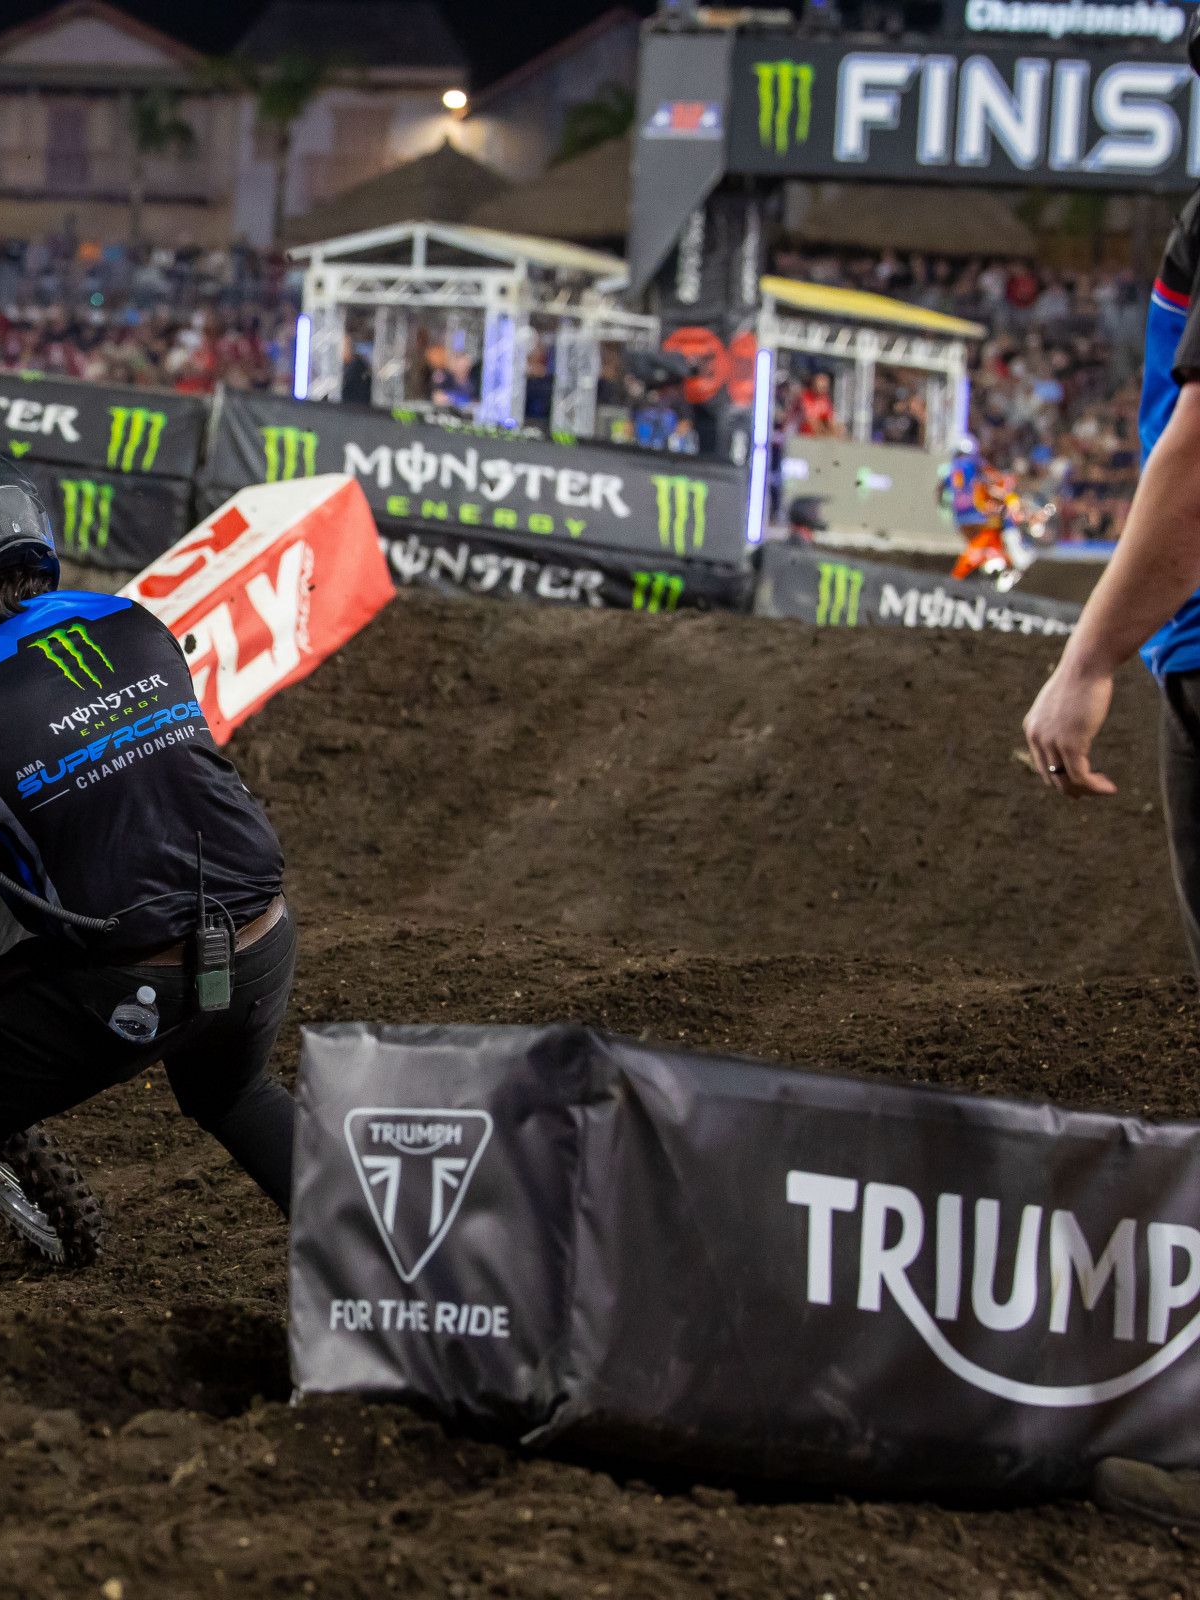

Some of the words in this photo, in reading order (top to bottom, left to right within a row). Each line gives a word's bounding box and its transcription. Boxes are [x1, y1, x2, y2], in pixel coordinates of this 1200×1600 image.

[965, 0, 1186, 42] Championship
[833, 52, 1200, 178] FINIS
[343, 441, 632, 518] MONSTER
[386, 495, 588, 539] ENERGY
[380, 533, 606, 608] ONSTER
[49, 673, 169, 735] MONSTER
[80, 695, 159, 736] ENERGY
[15, 759, 45, 781] AMA
[75, 724, 196, 790] CHAMPIONSHIP
[368, 1122, 463, 1155] TRIUMPH
[785, 1169, 1200, 1407] TRIUMP
[329, 1300, 373, 1331] FOR
[378, 1300, 430, 1332] THE
[435, 1302, 511, 1339] RIDE
